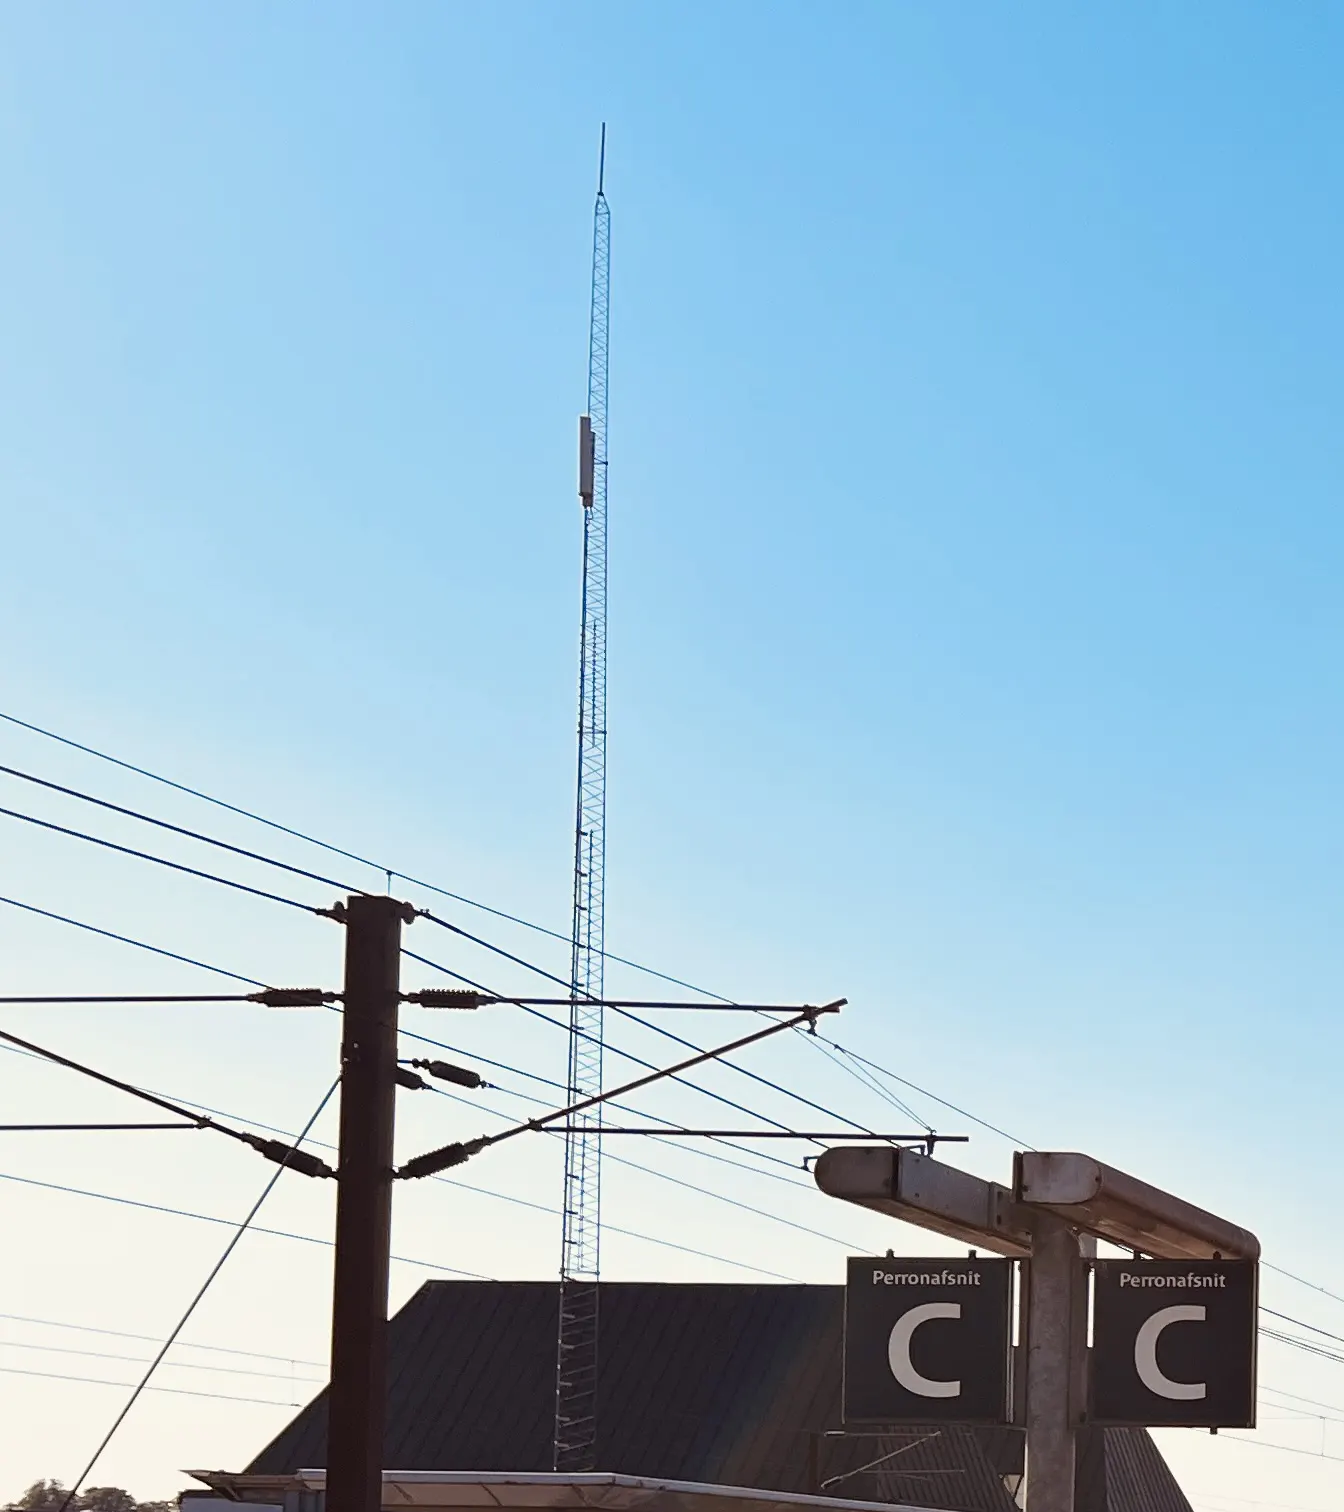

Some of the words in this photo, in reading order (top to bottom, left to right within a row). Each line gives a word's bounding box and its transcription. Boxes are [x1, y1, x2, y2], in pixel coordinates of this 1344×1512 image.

[872, 1269, 981, 1286] Perronafsnit
[1119, 1272, 1226, 1289] Perronafsnit
[888, 1302, 961, 1399] C
[1134, 1304, 1207, 1401] C
